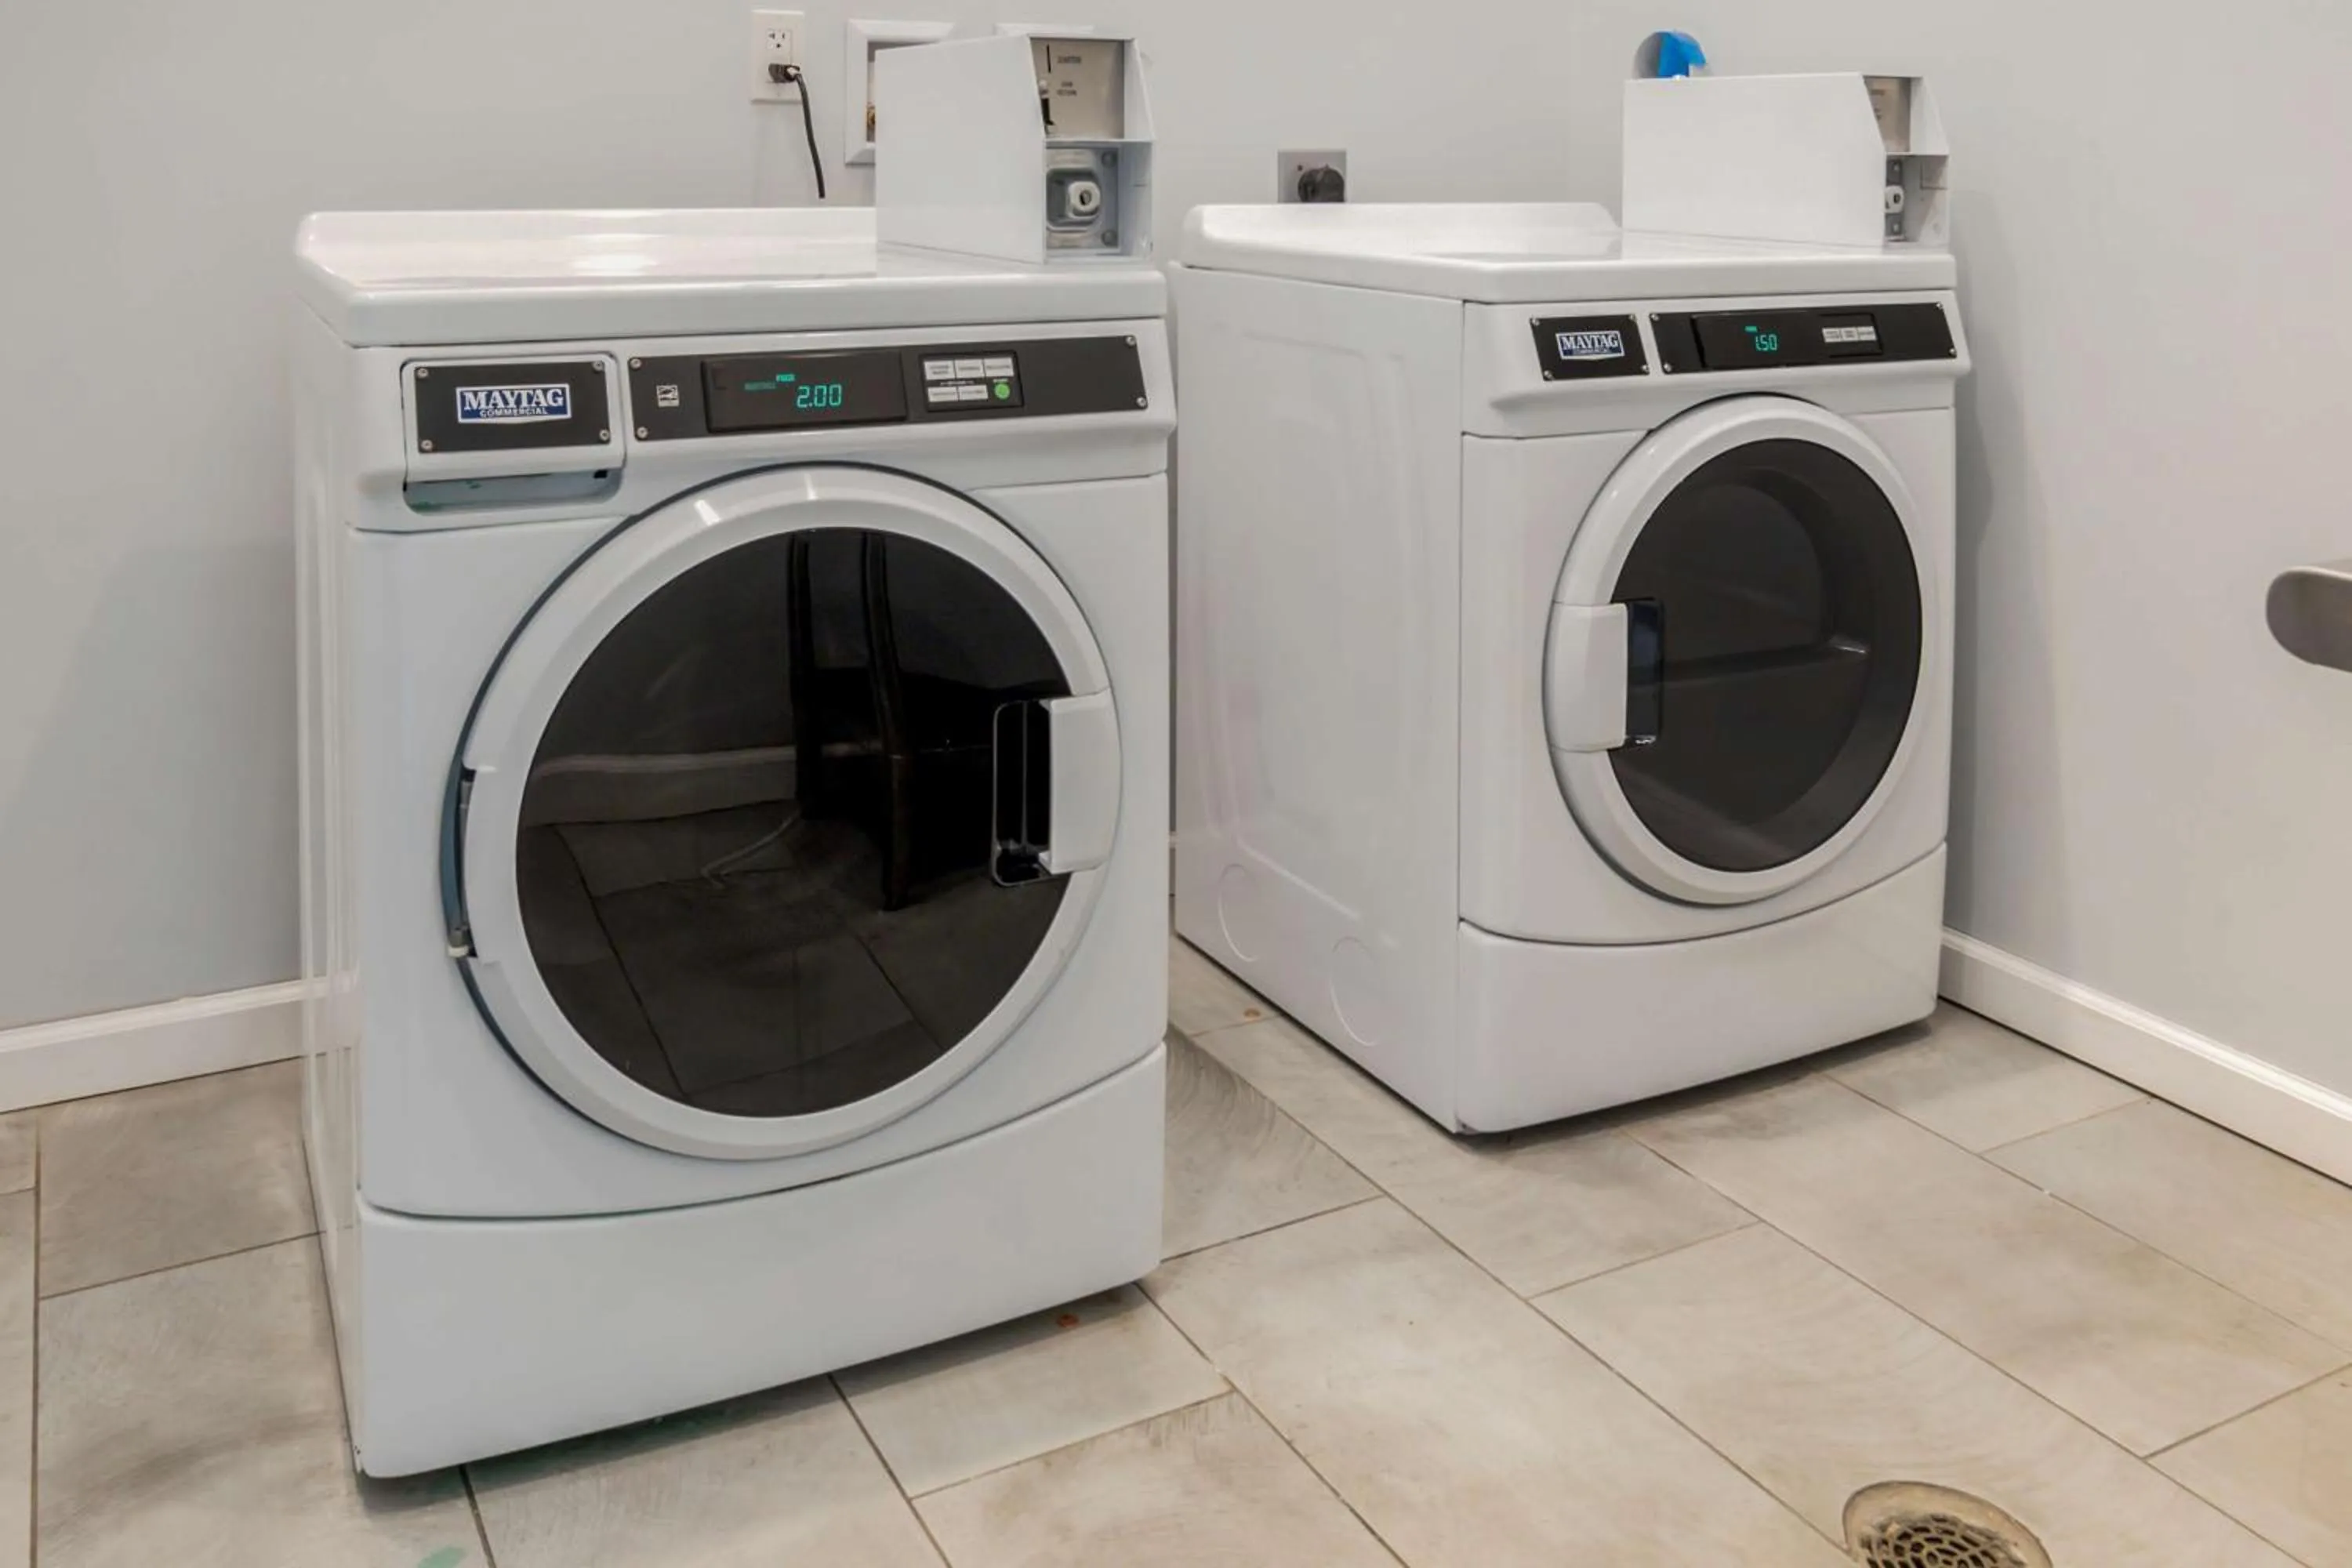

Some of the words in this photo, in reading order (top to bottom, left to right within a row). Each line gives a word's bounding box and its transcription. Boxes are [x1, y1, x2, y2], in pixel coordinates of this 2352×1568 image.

[1560, 333, 1619, 350] MAYTAG
[463, 388, 564, 410] MAYTAG
[797, 384, 843, 408] 2.00
[479, 406, 548, 418] COMMERCIAL
